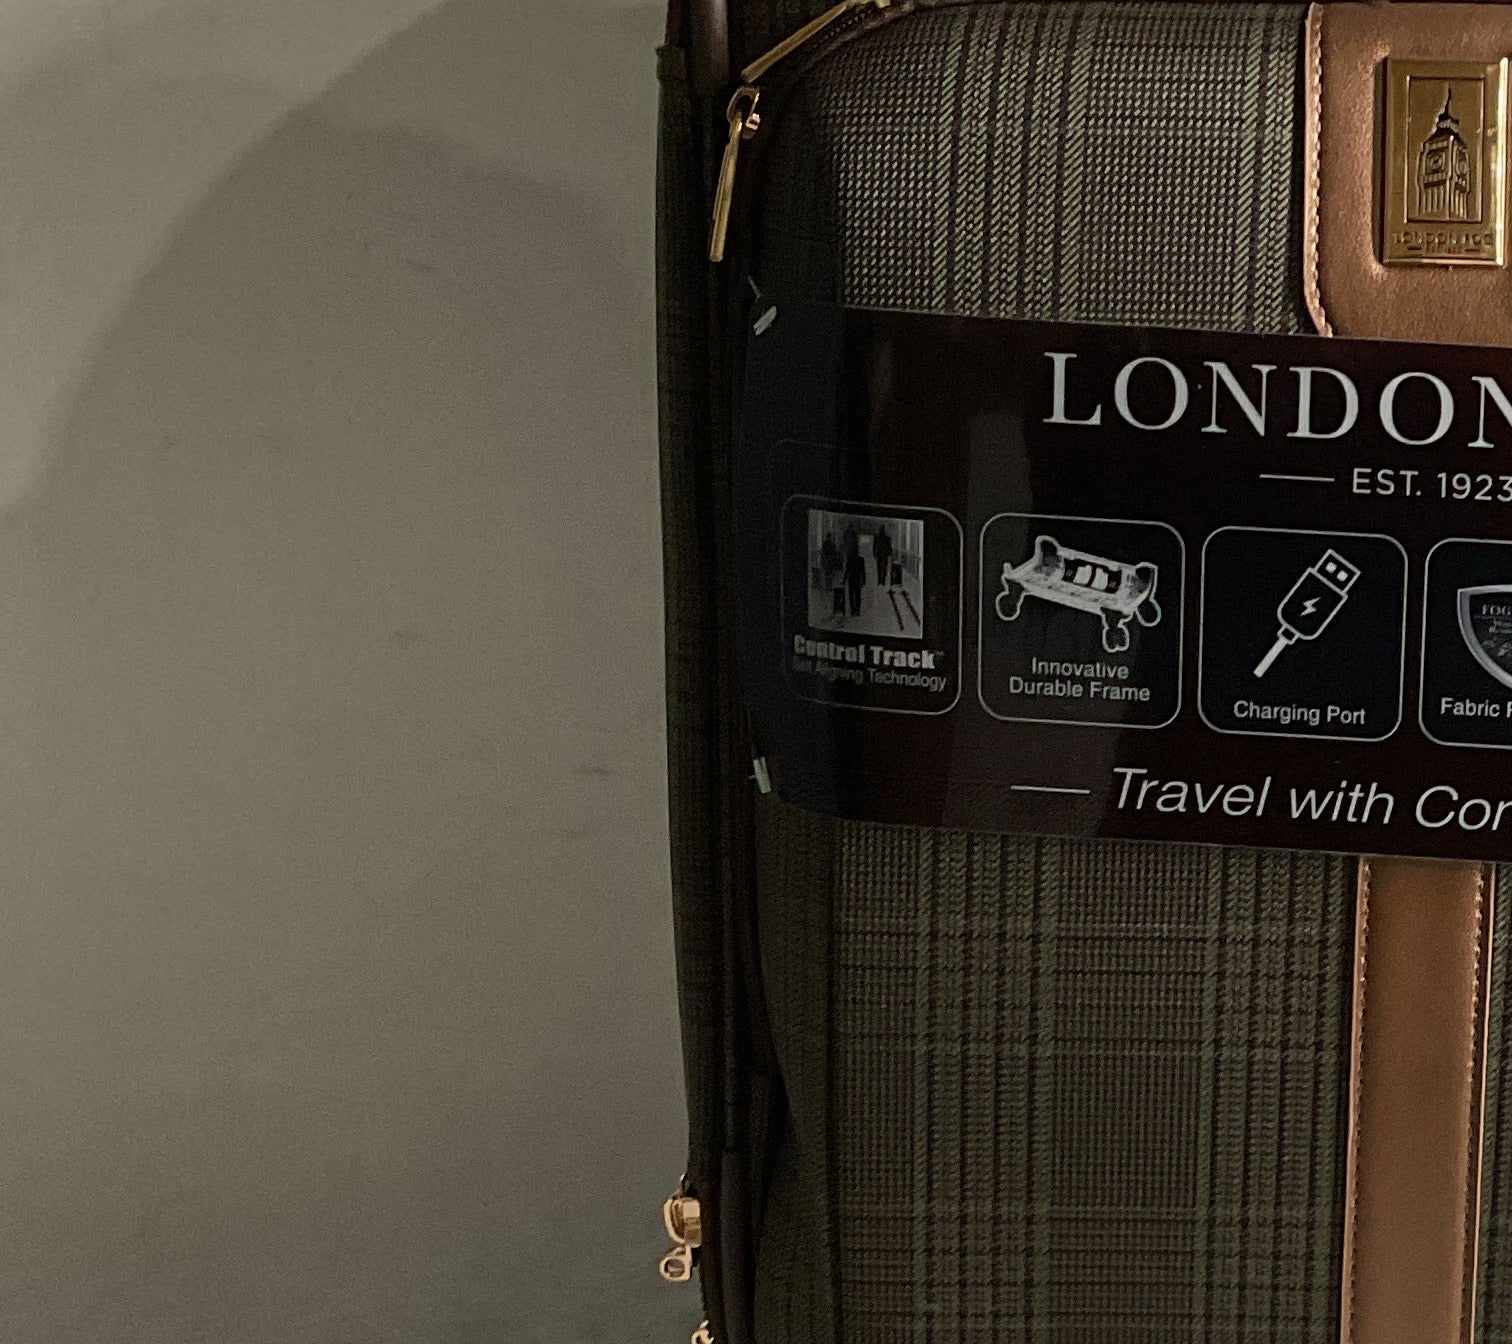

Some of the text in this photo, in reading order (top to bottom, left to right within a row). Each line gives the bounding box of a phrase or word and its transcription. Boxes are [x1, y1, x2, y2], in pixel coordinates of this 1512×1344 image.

[1352, 467, 1422, 497] EST.
[1481, 604, 1512, 617] FOG
[869, 645, 936, 670] Track
[1031, 656, 1130, 680] Innovative
[867, 667, 948, 693] Technology
[1009, 675, 1151, 702] Durable Frame
[1233, 700, 1366, 727] Charging Port
[1440, 696, 1500, 718] Fabric
[1113, 767, 1272, 817] Travel
[1290, 780, 1395, 825] with
